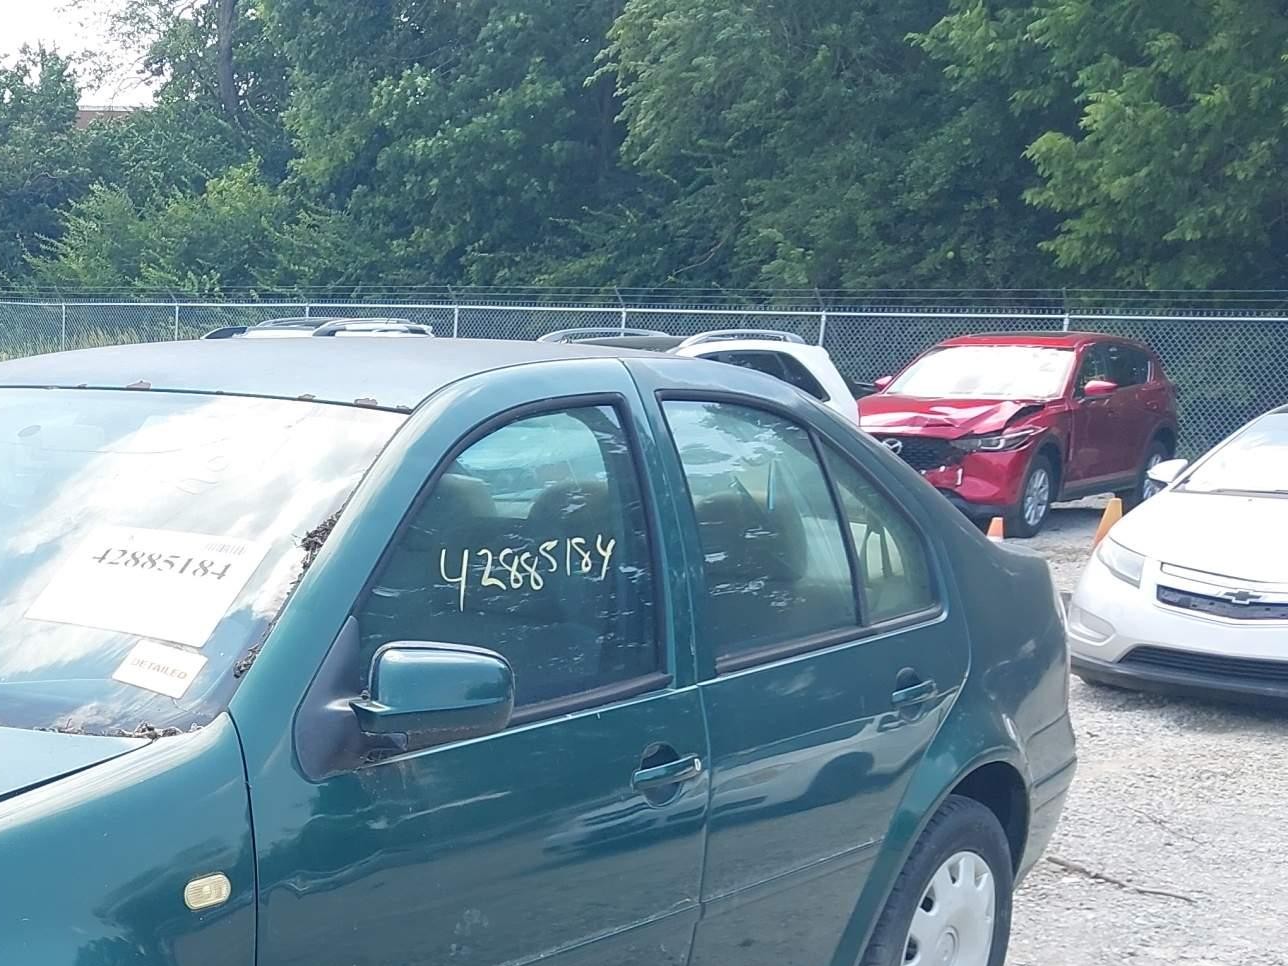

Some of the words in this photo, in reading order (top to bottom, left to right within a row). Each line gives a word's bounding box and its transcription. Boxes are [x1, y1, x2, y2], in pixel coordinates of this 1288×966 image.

[91, 547, 232, 580] 42885184
[439, 533, 618, 613] 42885184
[130, 656, 189, 680] DETAILED
